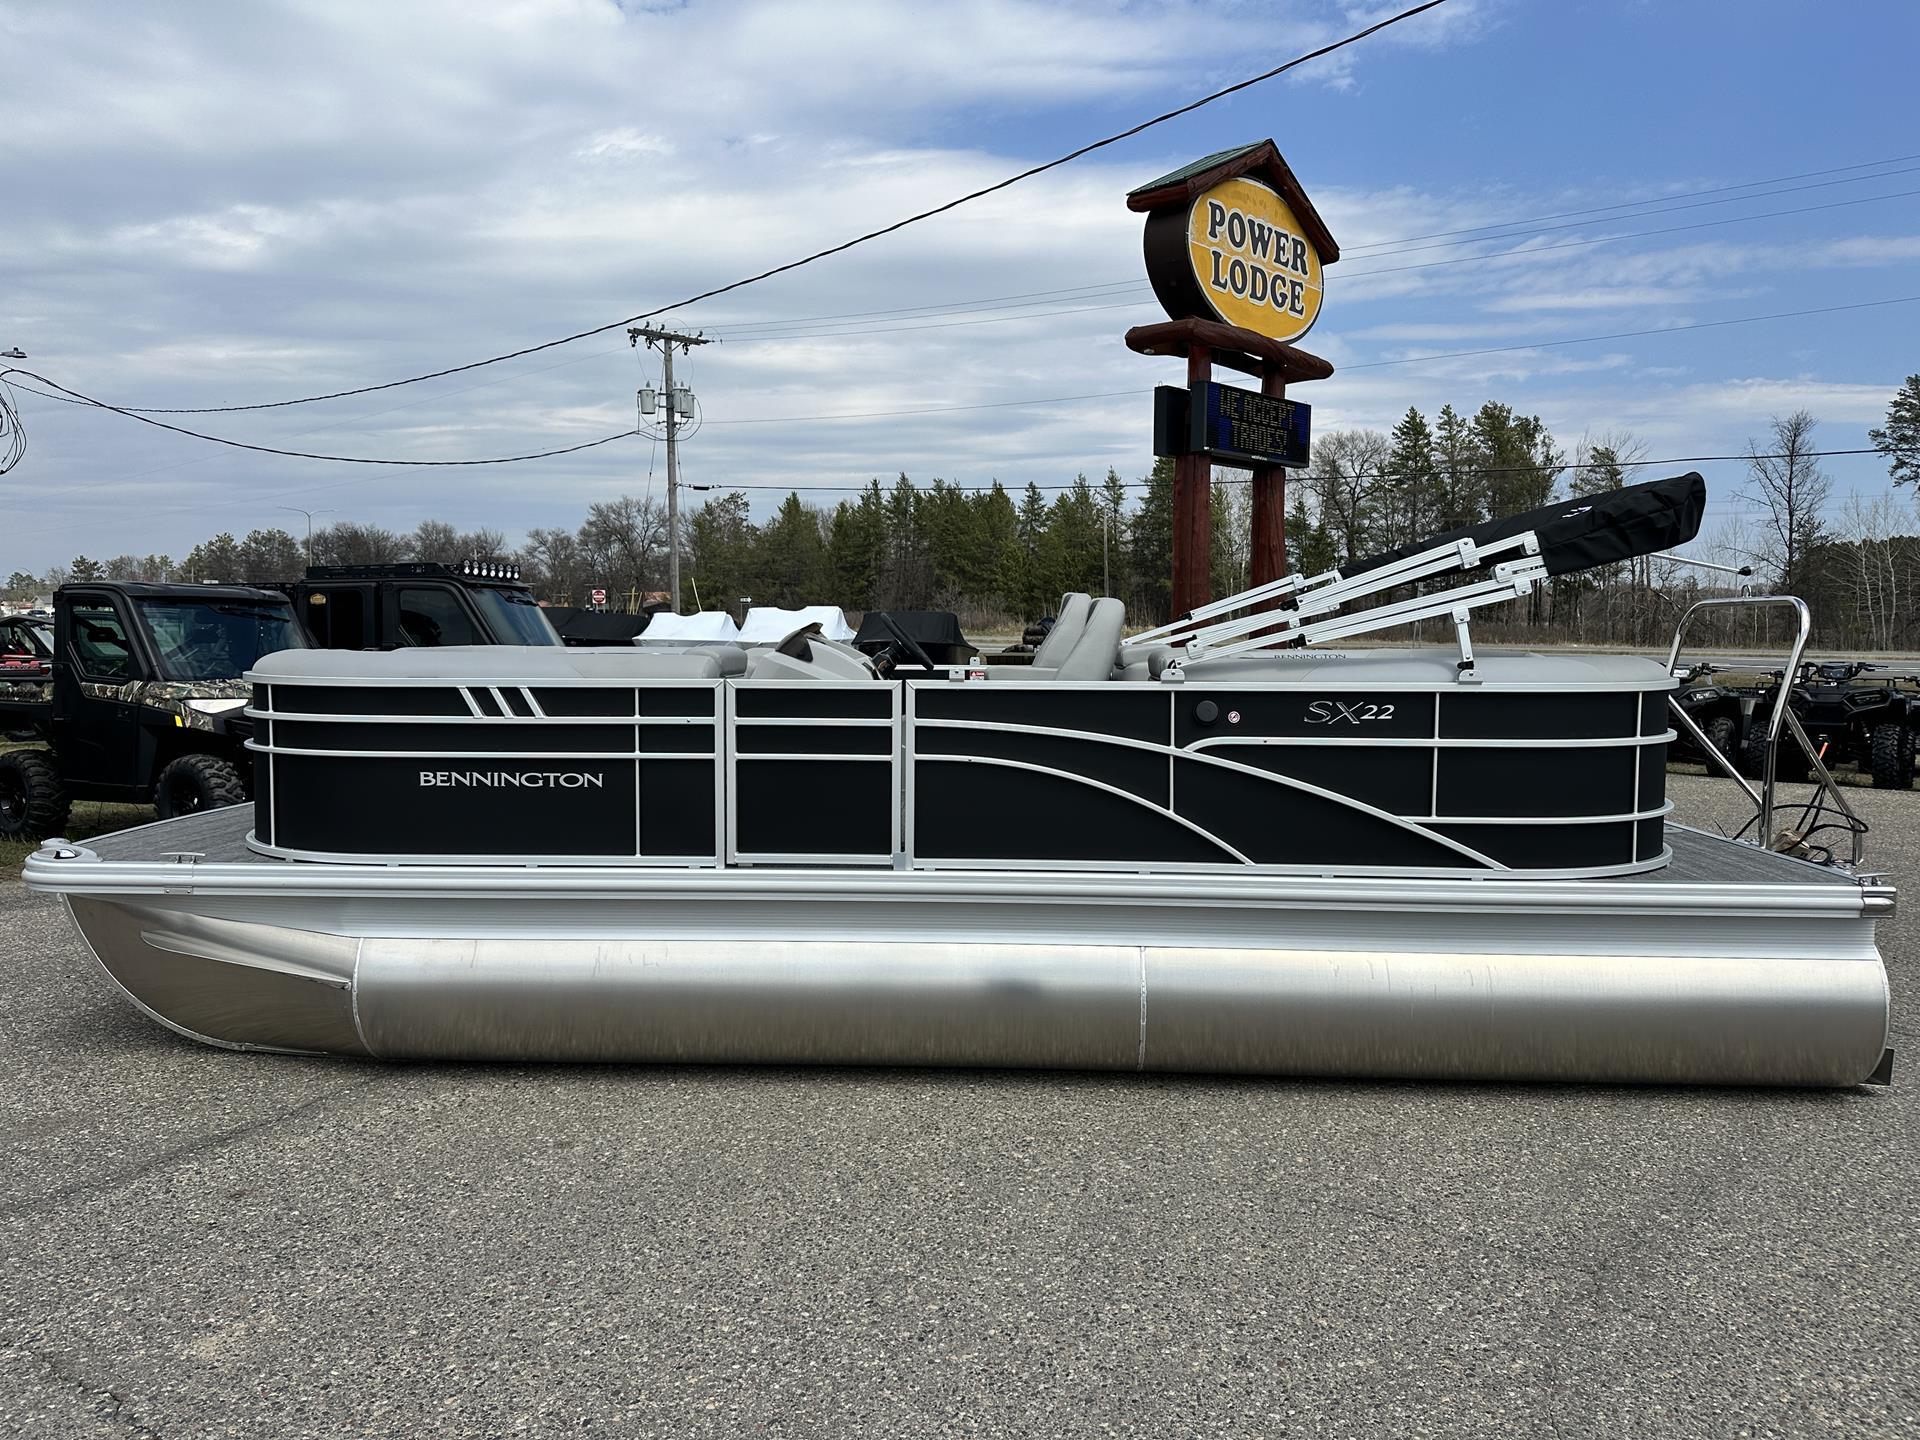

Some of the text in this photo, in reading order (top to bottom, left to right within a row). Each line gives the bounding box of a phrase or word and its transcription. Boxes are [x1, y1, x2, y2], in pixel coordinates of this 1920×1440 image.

[1208, 201, 1308, 276] POWER
[1211, 249, 1305, 316] LODGE
[1220, 388, 1296, 430] WE ACCEPT
[419, 771, 604, 788] BENNINGTON
